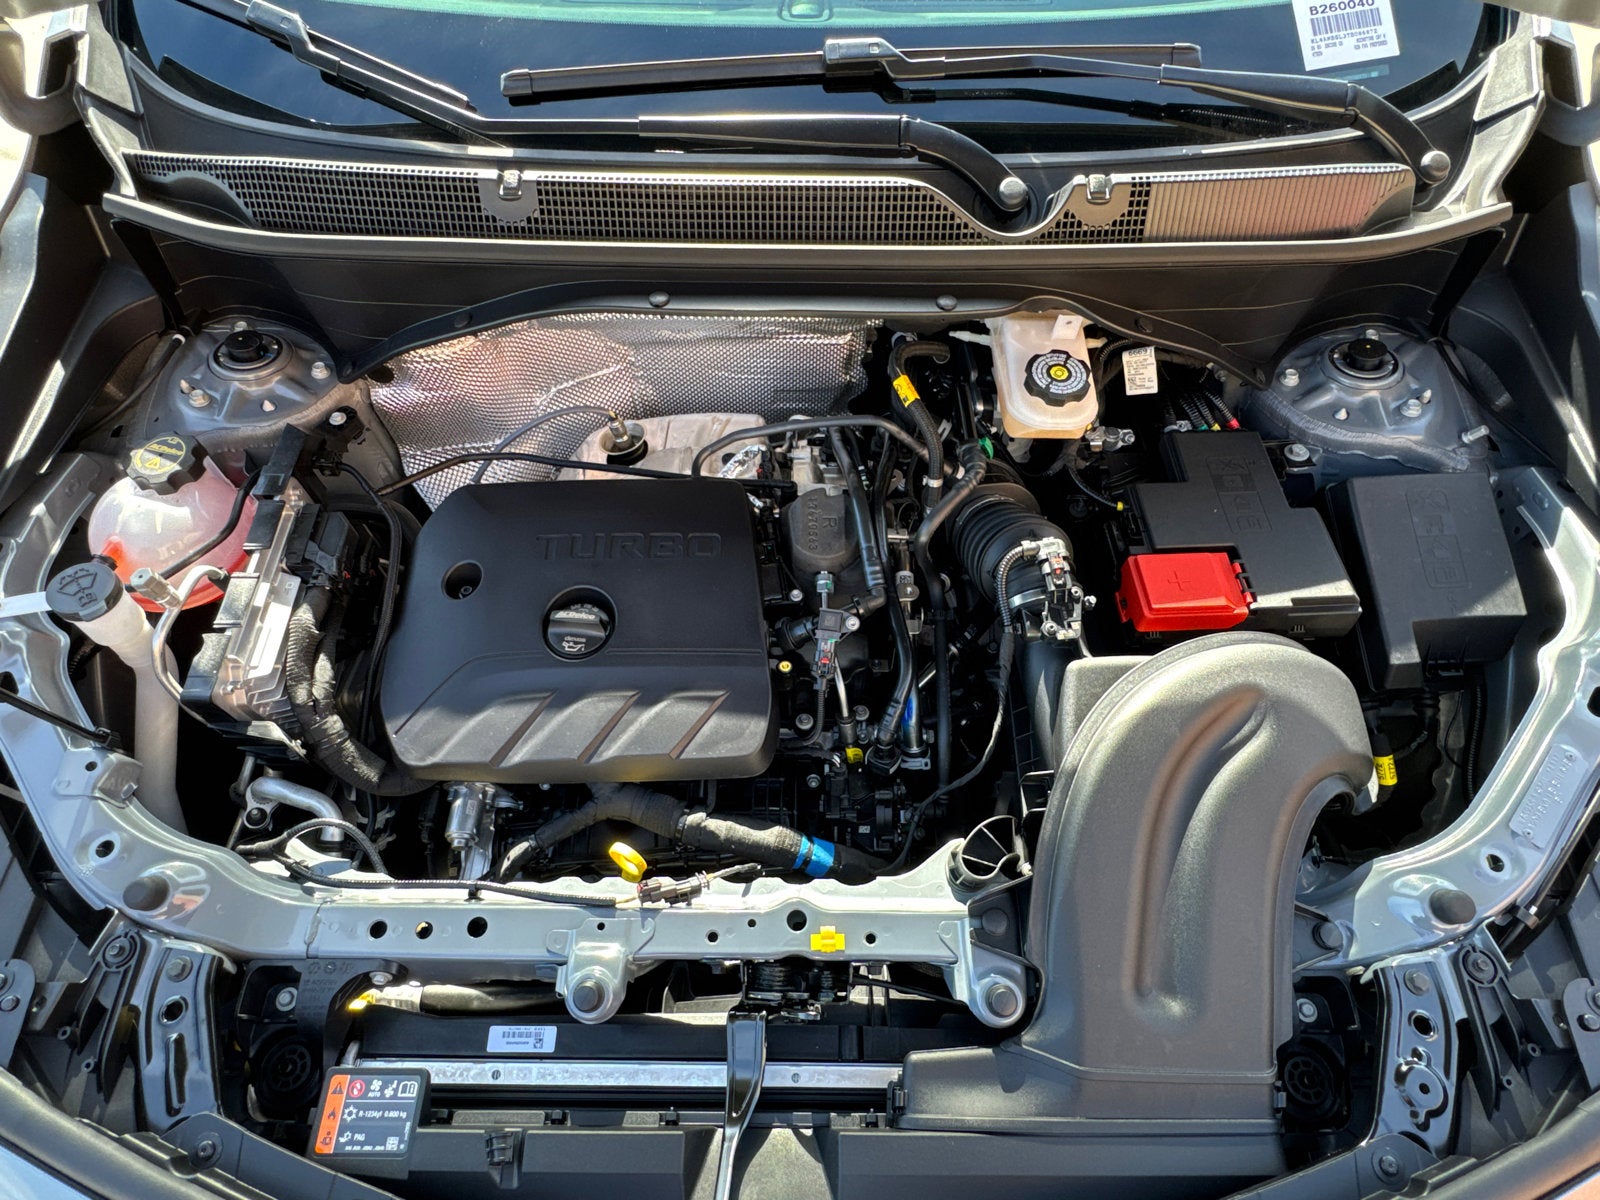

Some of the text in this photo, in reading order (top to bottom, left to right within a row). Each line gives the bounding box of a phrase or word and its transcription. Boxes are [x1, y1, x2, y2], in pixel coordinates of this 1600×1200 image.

[1309, 0, 1375, 16] B260040
[536, 532, 722, 560] TURBO
[358, 1110, 383, 1119] R-1234yf
[400, 1110, 407, 1119] kg
[353, 1133, 366, 1141] PAG
